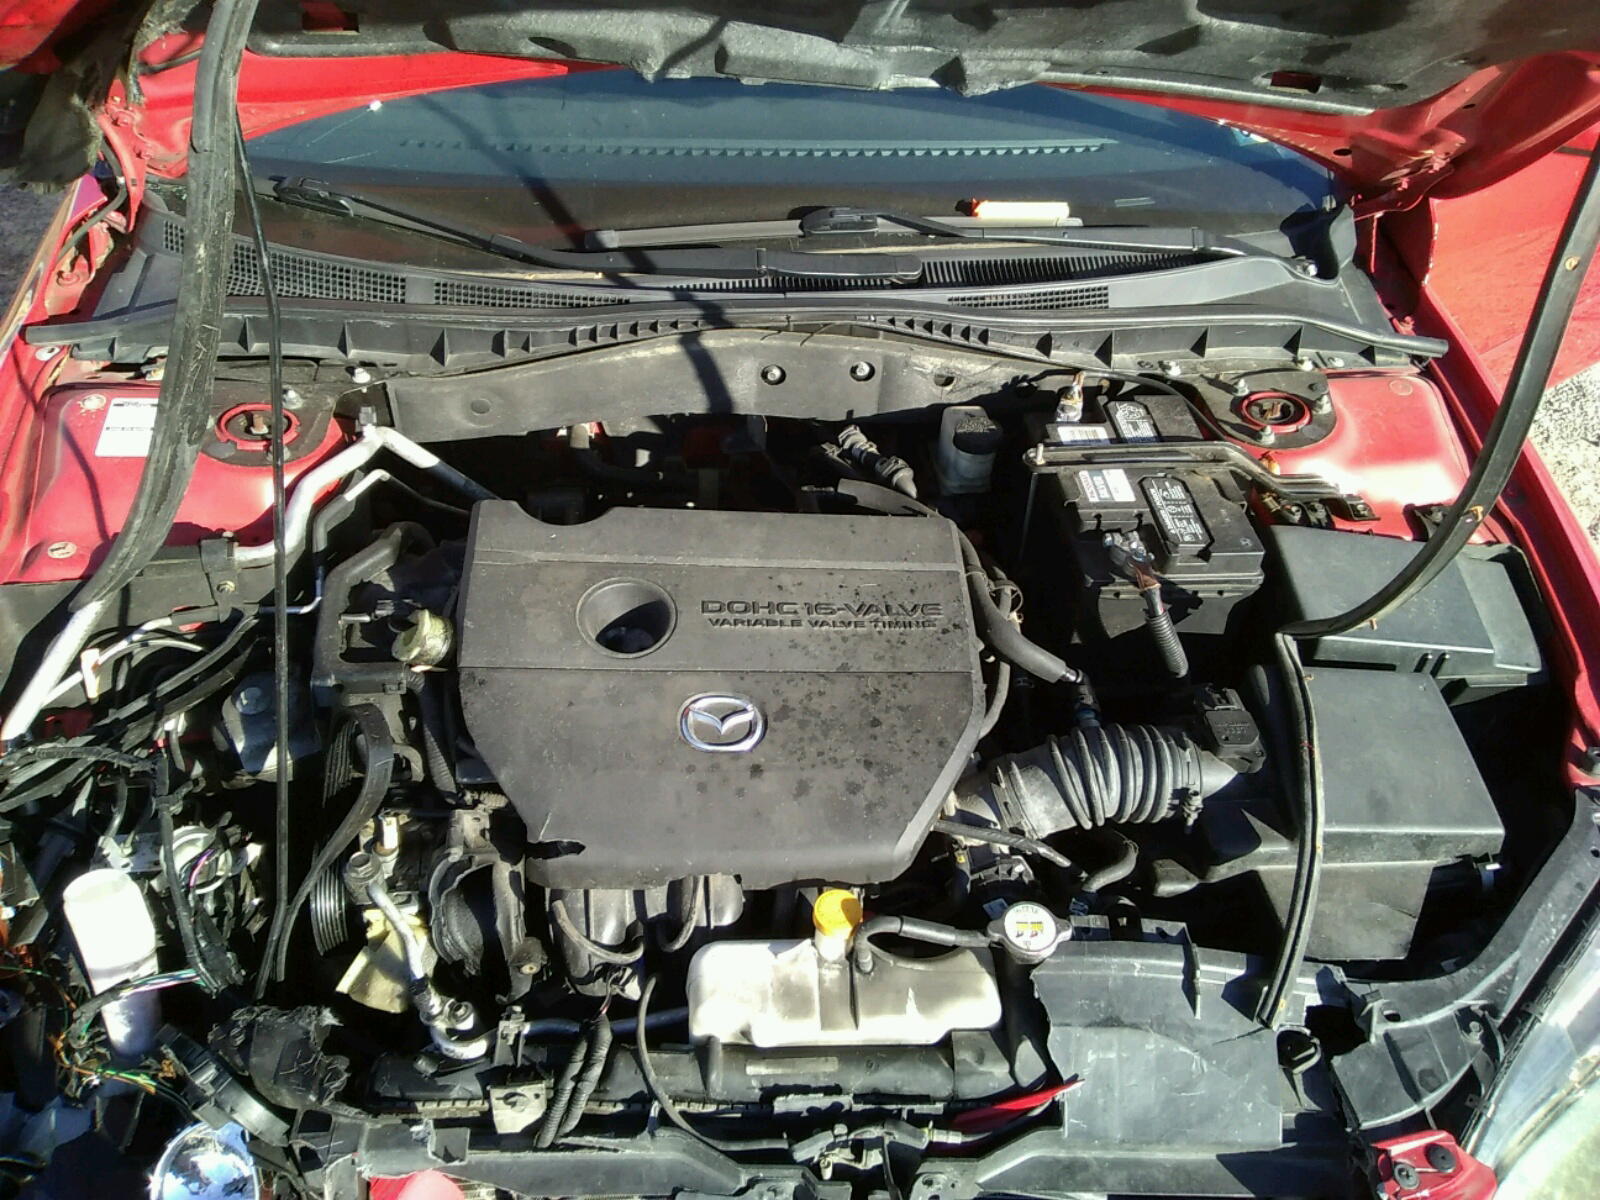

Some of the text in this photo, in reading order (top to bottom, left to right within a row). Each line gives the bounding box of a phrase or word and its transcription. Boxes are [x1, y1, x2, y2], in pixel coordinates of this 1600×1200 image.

[701, 600, 943, 617] DOHC 16-VALVE
[708, 618, 938, 629] VARIABLE VALVE TIMING
